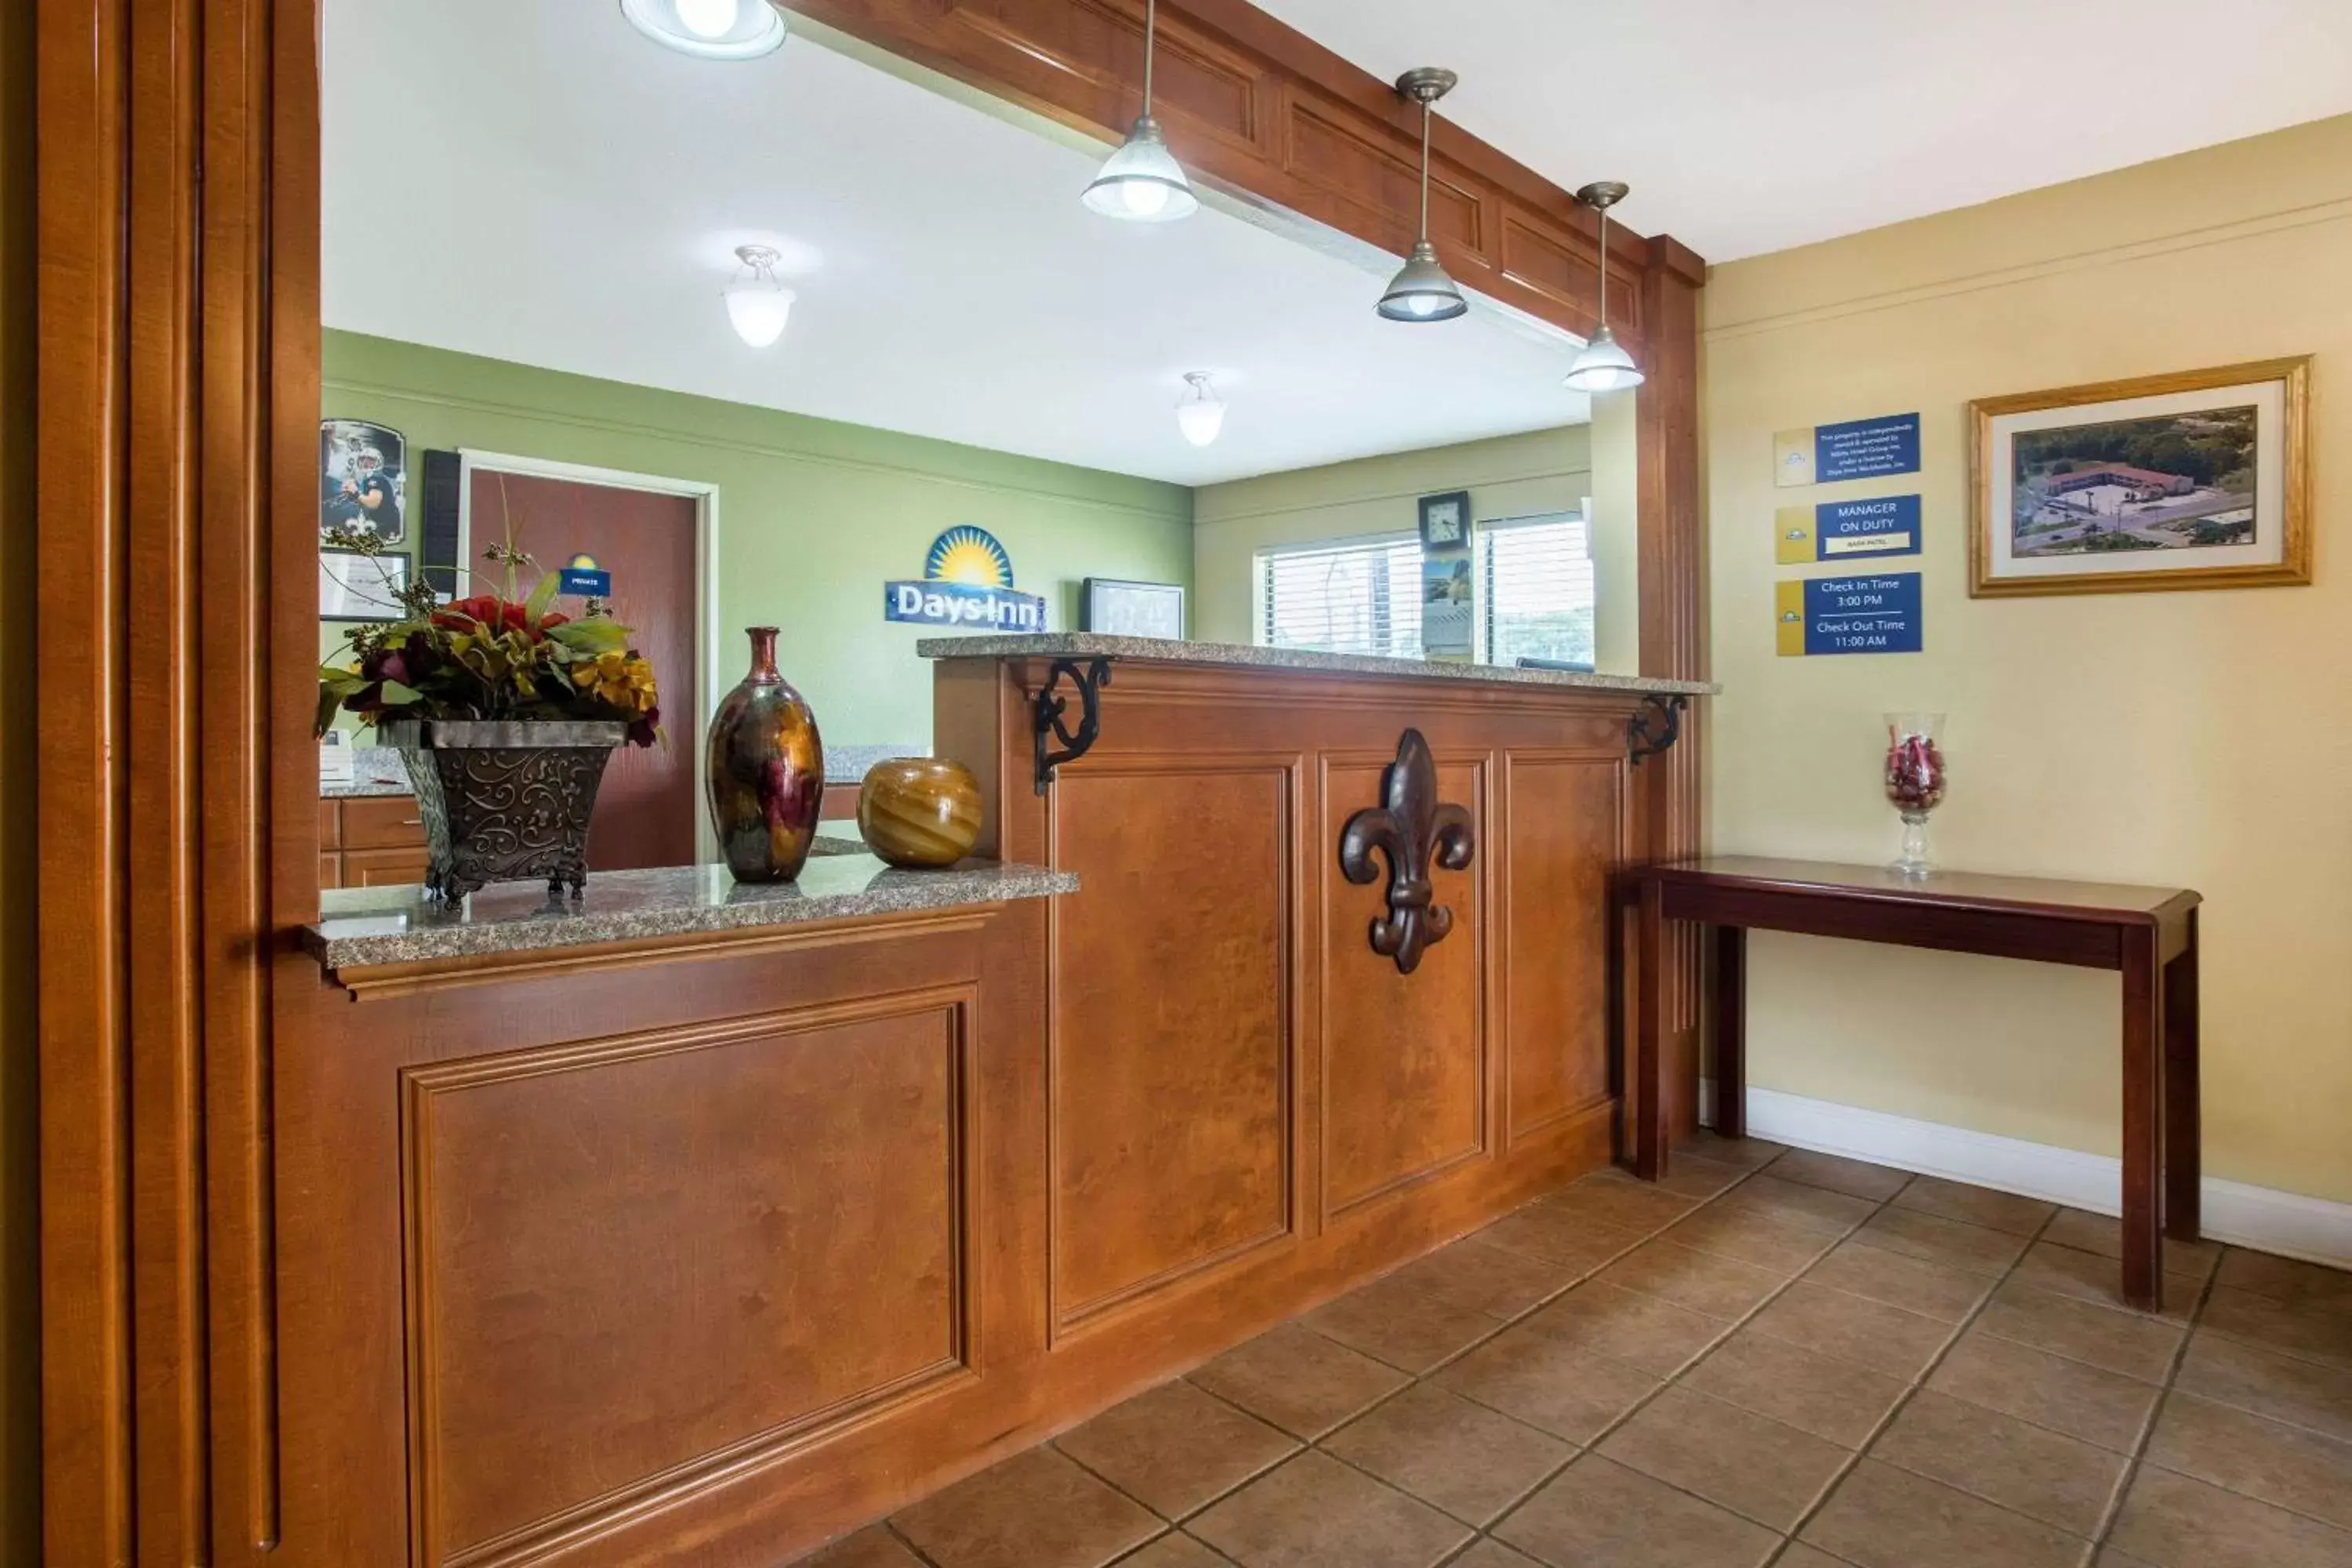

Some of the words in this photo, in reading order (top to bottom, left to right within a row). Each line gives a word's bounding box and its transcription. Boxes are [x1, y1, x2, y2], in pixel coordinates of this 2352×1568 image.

[1838, 503, 1897, 518] MANAGER
[1840, 521, 1859, 533] ON
[1862, 518, 1895, 531] DUTY
[1821, 581, 1854, 593] Check
[1857, 581, 1868, 590] In
[1871, 579, 1900, 590] Time
[898, 585, 980, 624] Days
[986, 593, 1037, 627] Inn
[1837, 596, 1860, 607] 3:00
[1864, 595, 1882, 605] PM
[1817, 621, 1849, 633] Check
[1853, 621, 1874, 631] Out
[1876, 620, 1905, 630] Time
[1835, 636, 1864, 647] 11:00
[1867, 635, 1887, 646] AM
